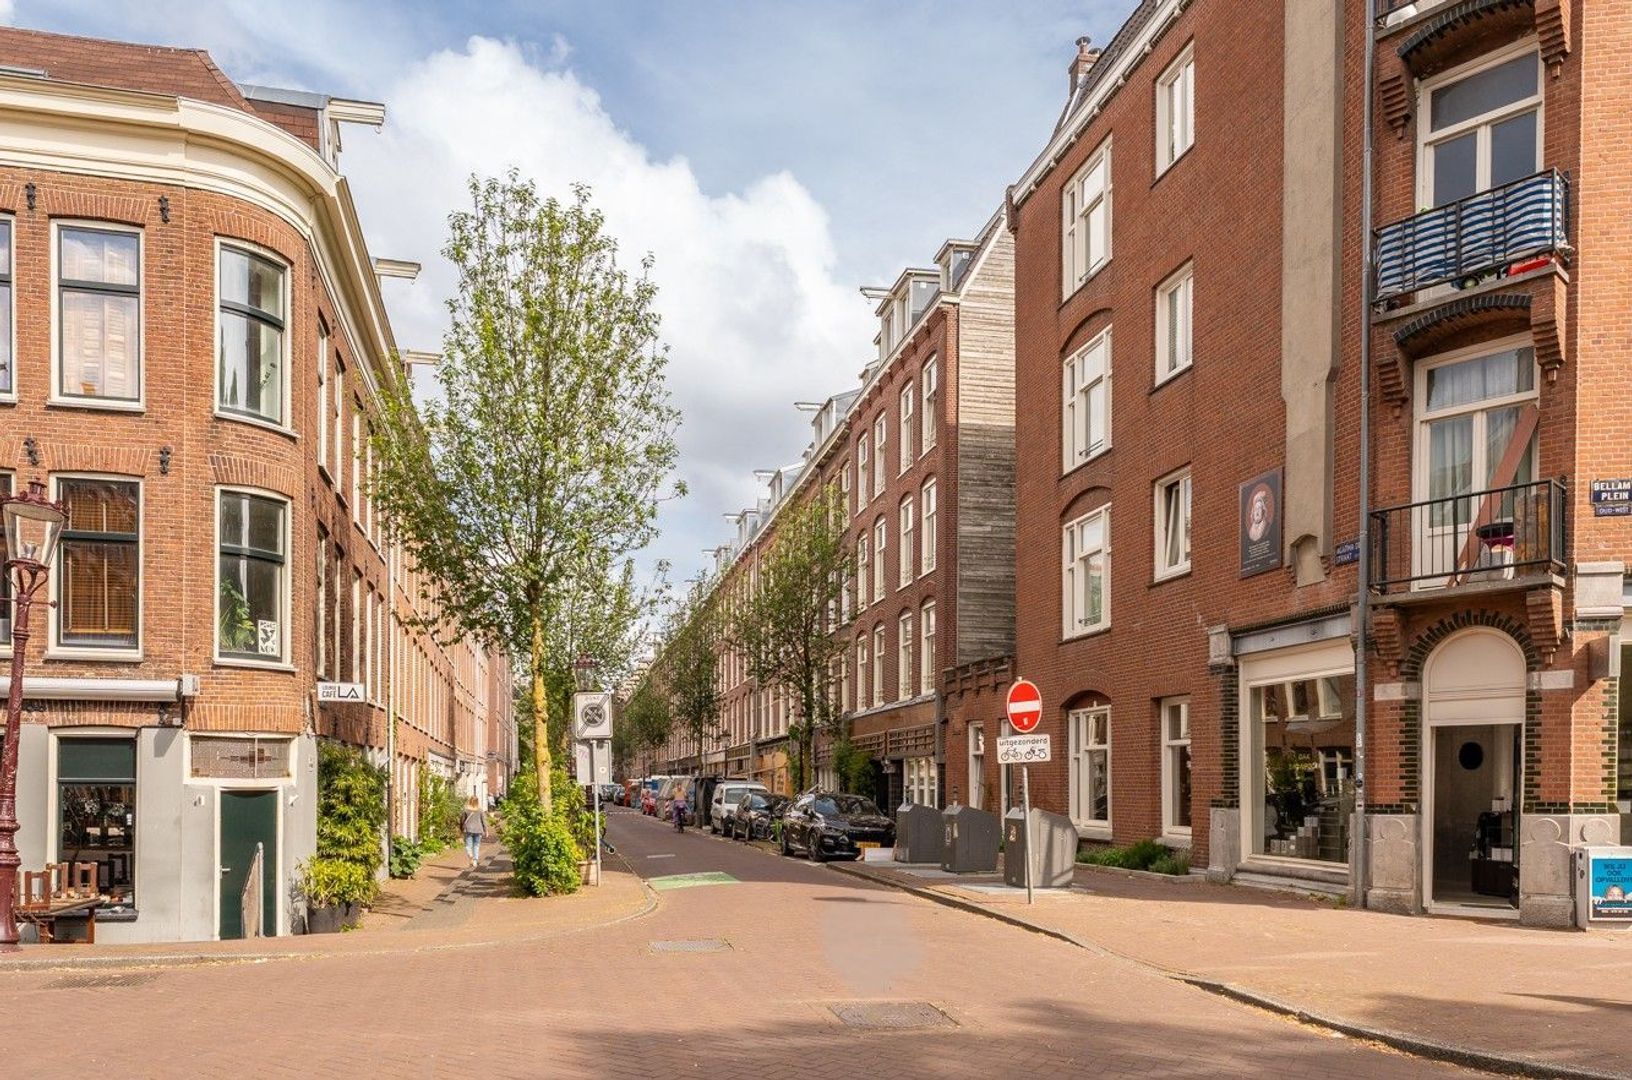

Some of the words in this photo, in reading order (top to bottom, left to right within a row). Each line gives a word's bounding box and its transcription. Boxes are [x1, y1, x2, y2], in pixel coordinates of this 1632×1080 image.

[1593, 481, 1631, 491] BELLAM
[1601, 491, 1629, 501] PLEIN
[338, 685, 359, 699] LA
[999, 737, 1048, 747] uitgezonderd
